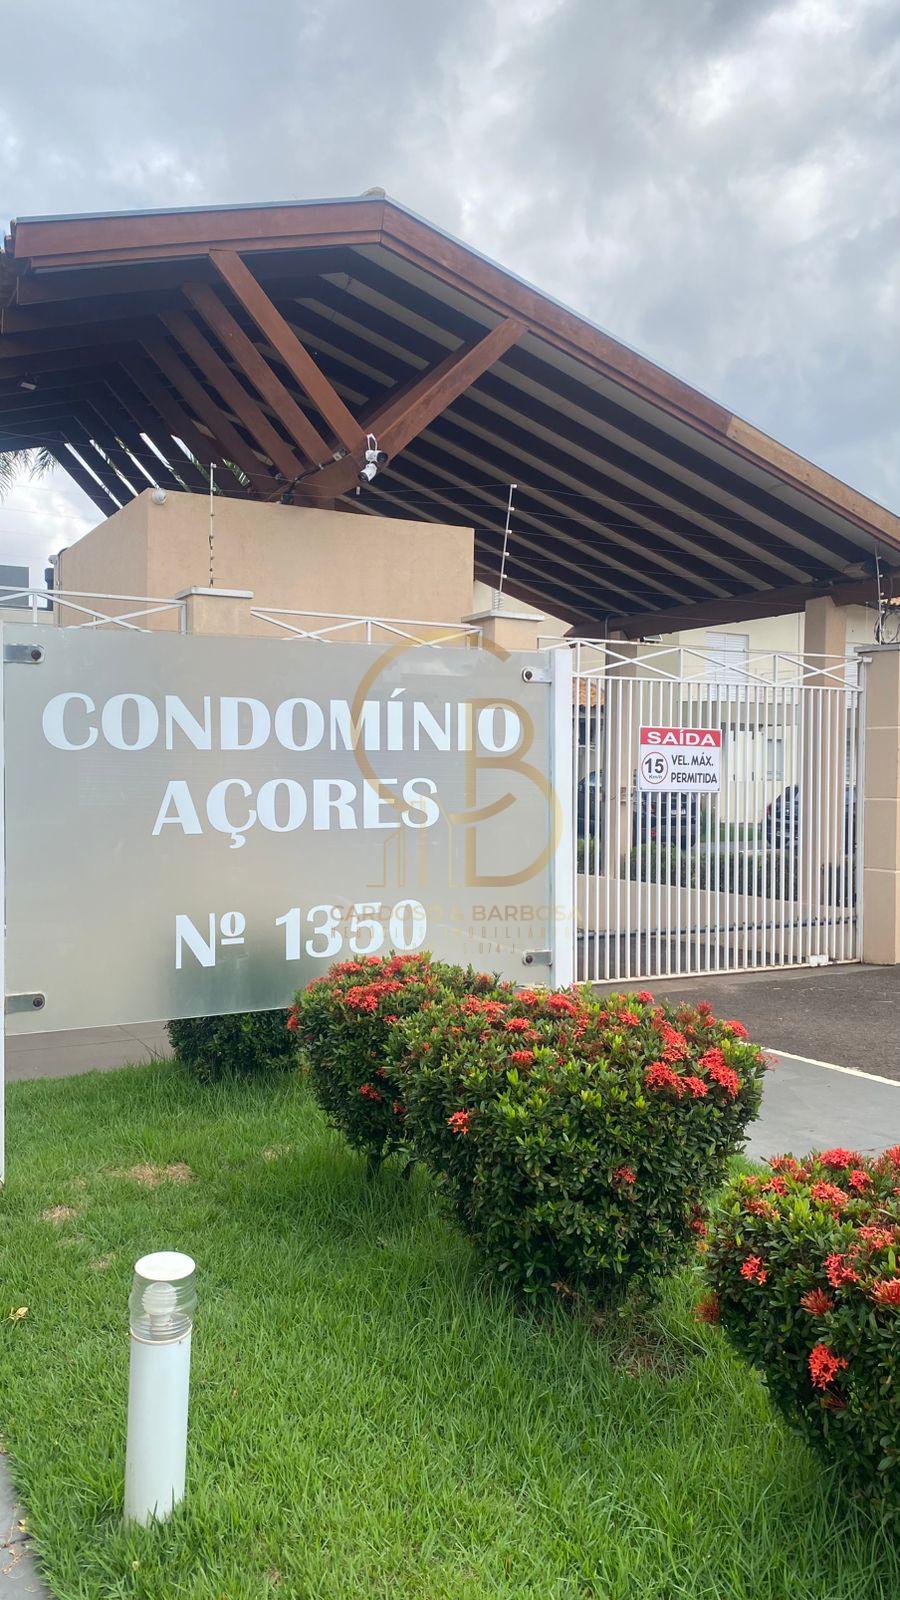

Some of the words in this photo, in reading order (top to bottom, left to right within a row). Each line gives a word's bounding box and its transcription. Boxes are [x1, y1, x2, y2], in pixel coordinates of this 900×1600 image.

[41, 687, 522, 753] CONDOMÍNIO
[646, 729, 716, 746] SAÍDA
[644, 757, 664, 774] 15
[671, 754, 690, 766] VEL.
[691, 752, 714, 767] MÁX.
[670, 772, 718, 784] PERMITIDA
[151, 777, 441, 850] AÇORES
[275, 899, 428, 962] 1350
